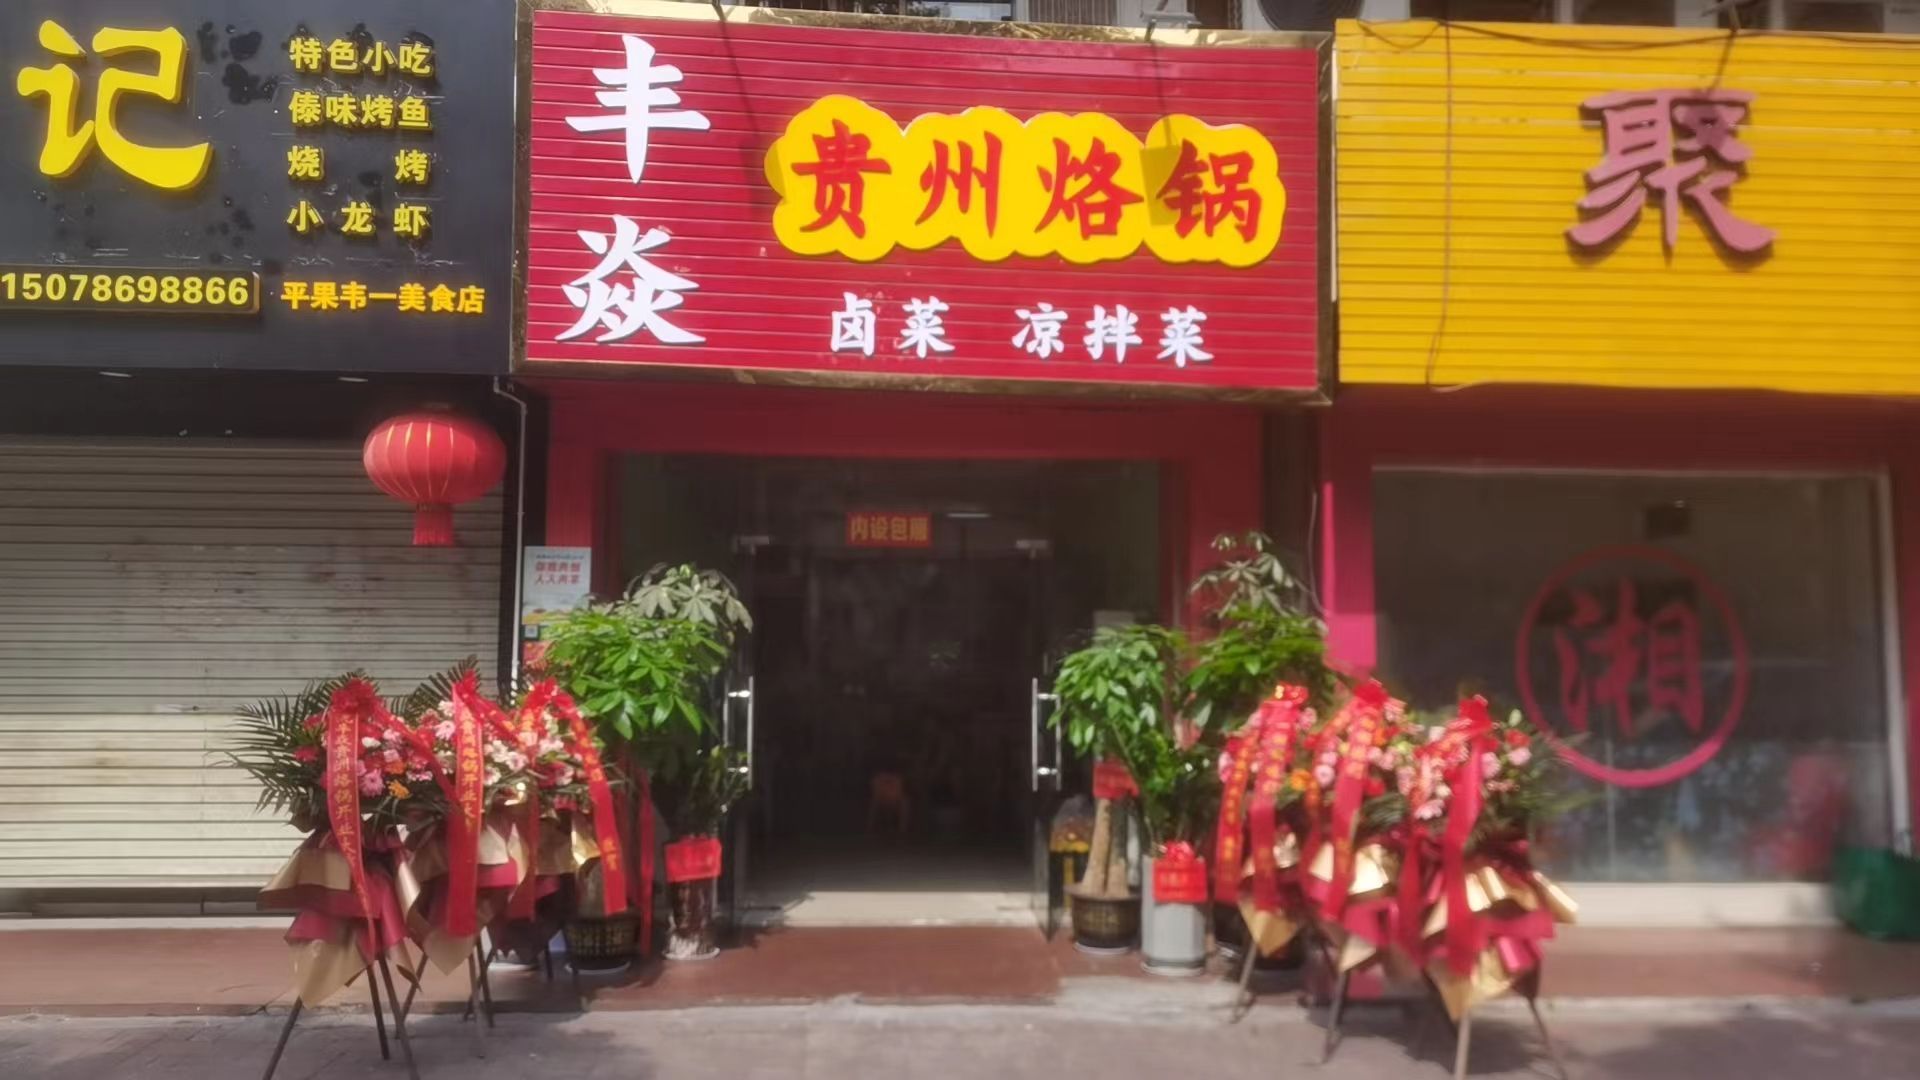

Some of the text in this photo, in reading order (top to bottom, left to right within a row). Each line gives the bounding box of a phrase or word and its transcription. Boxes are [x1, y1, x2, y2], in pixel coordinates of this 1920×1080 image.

[290, 38, 432, 76] 特色小吃
[17, 20, 212, 189] 记
[289, 92, 431, 129] 傣味烤鱼
[287, 146, 430, 183] 烧烤
[556, 33, 712, 345] 丰焱
[791, 118, 1264, 244] 贵州烙锅
[1566, 87, 1780, 262] 聚
[287, 202, 428, 237] 小龙虾
[2, 272, 249, 304] 15078698866
[281, 281, 485, 314] 平果韦一美食店
[830, 293, 1214, 369] 卤菜 凉拌菜
[1553, 575, 1704, 740] 湘
